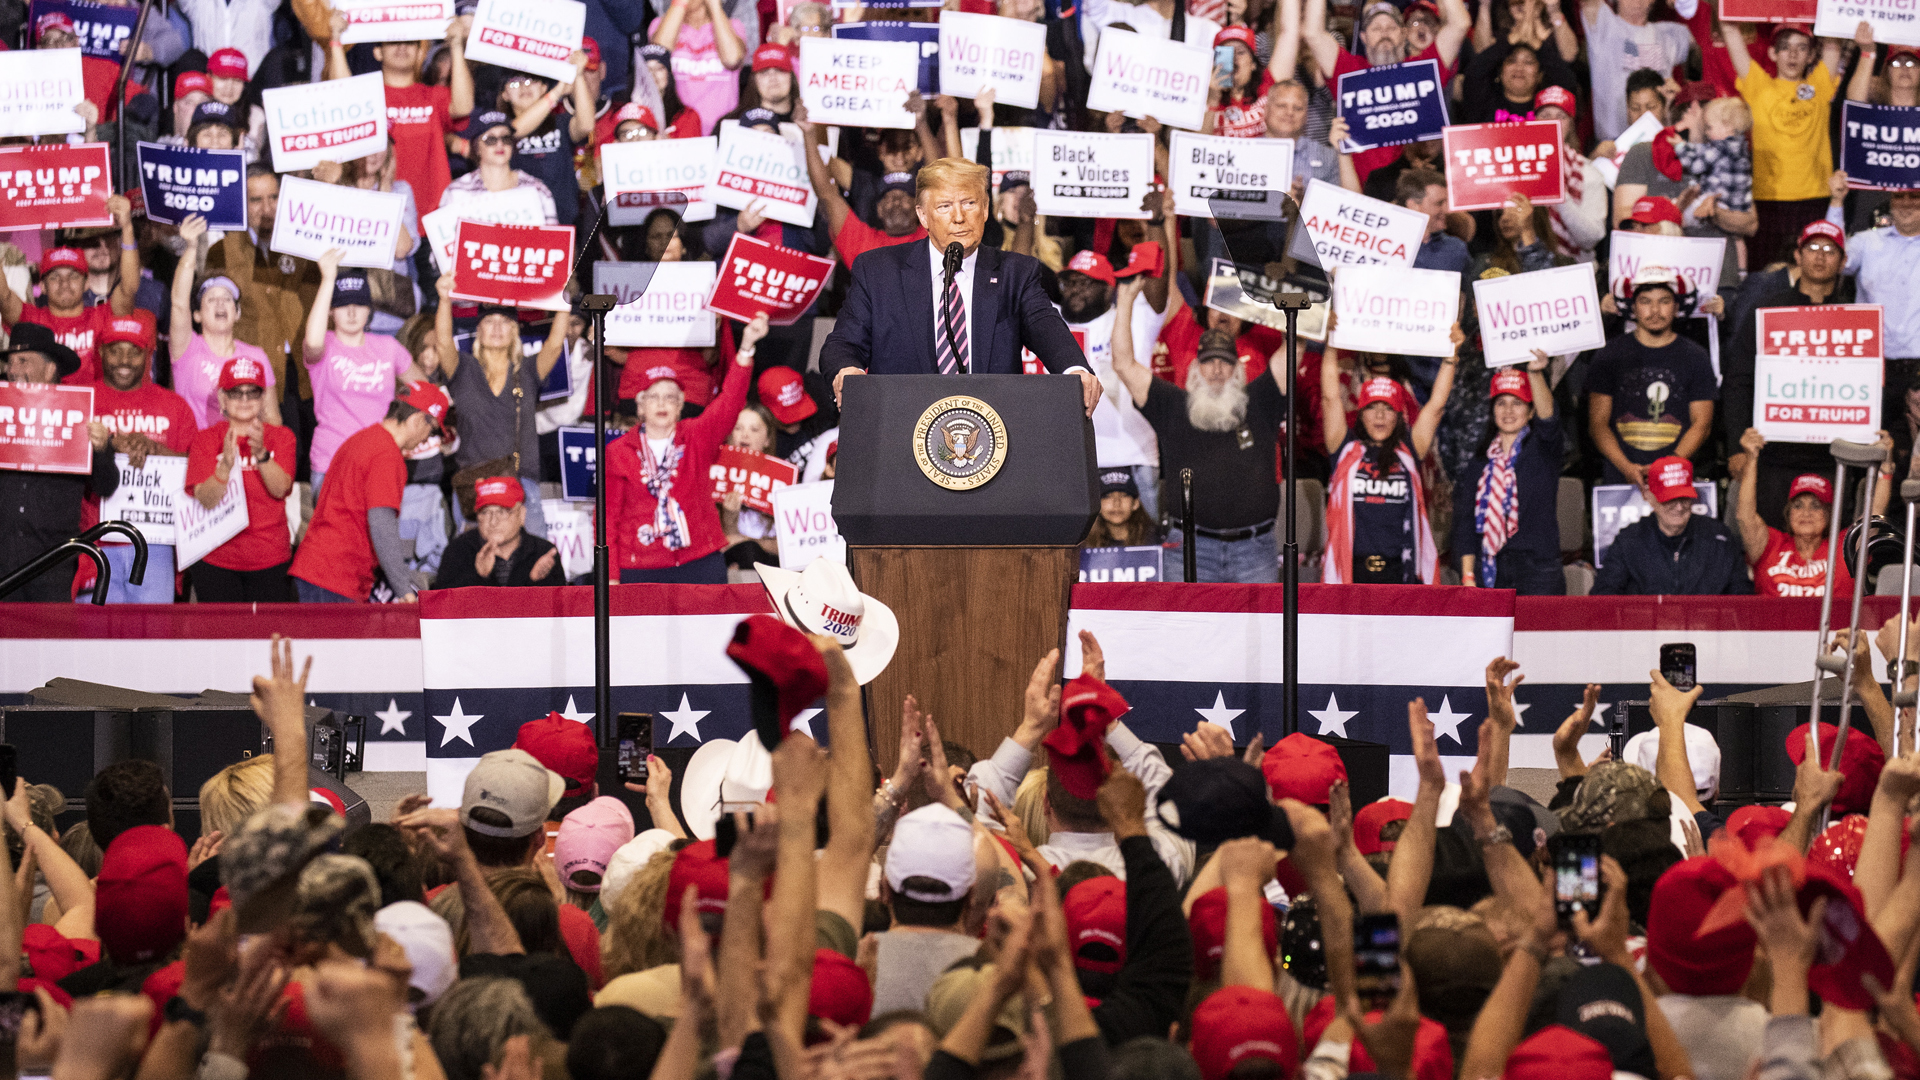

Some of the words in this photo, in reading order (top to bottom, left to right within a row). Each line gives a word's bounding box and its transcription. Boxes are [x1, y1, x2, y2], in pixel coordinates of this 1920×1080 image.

[351, 9, 386, 22] FOR
[388, 4, 442, 20] TRUMP
[487, 1, 574, 41] Latinos
[1838, 7, 1864, 17] FOR
[1870, 10, 1915, 21] TRUMP
[72, 20, 130, 39] UMP
[482, 30, 514, 47] FOR
[516, 37, 570, 59] TRUMP
[948, 35, 1035, 71] Women
[833, 55, 882, 69] KEEP
[808, 73, 908, 92] AMERICA
[955, 65, 976, 75] FOR
[982, 69, 1024, 82] TRUMP
[1107, 52, 1200, 94] Women
[0, 79, 73, 99] omen
[1112, 82, 1138, 94] FOR
[1146, 89, 1188, 104] TRUMP
[1342, 80, 1435, 108] TRUMP
[278, 100, 375, 129] Latinos
[1364, 109, 1418, 130] 2020
[284, 134, 320, 150] FOR
[322, 123, 375, 147] TRUMP
[1846, 121, 1920, 143] TRUM
[725, 144, 810, 184] Latinos
[1053, 145, 1096, 163] Black
[1192, 147, 1235, 166] Black
[1454, 143, 1555, 166] TRUMP
[0, 165, 101, 188] TRUMP
[143, 161, 240, 188] TRUMP
[614, 162, 708, 186] Latinos
[1077, 165, 1130, 182] Voices
[1216, 168, 1268, 186] Voices
[1465, 161, 1548, 177] PENCE
[7, 183, 92, 200] PENCE
[619, 193, 650, 205] FOR
[720, 173, 752, 191] FOR
[756, 181, 806, 205] TRUMP
[1055, 185, 1081, 197] FOR
[1085, 187, 1128, 198] TRUMP
[1191, 187, 1218, 198] FOR
[1221, 189, 1267, 201] TRUMP
[164, 191, 215, 212] 2020
[288, 198, 390, 238] Women
[1337, 204, 1390, 229] KEEP
[295, 229, 322, 241] FOR
[330, 236, 376, 247] TRUMP
[1305, 215, 1407, 260] AMERICA
[464, 241, 565, 266] TRUMP
[471, 258, 555, 277] PENCE
[733, 257, 819, 293] TRUMP
[603, 282, 705, 311] Women
[735, 276, 806, 303] PENCE
[1342, 286, 1447, 320] Women
[1486, 294, 1588, 330] Women
[614, 315, 642, 323] FOR
[649, 315, 697, 323] TRUMP
[1352, 319, 1383, 328] FOR
[1388, 321, 1435, 333] TRUMP
[1502, 330, 1528, 341] FOR
[1533, 320, 1581, 337] TRUMP
[1769, 328, 1874, 347] TRUMP
[1779, 345, 1864, 357] PENCE
[1767, 373, 1870, 401] Latinos
[0, 406, 84, 427] RUMP
[972, 402, 984, 412] THE
[1768, 406, 1804, 420] FOR
[1807, 408, 1866, 421] TRUMP
[916, 398, 960, 440] PRESIDENT
[6, 424, 73, 440] ENCE
[985, 410, 1005, 450] UNITED
[917, 442, 925, 457] THE
[920, 457, 929, 467] OF
[967, 457, 1000, 486] STATES
[122, 469, 161, 487] Black
[927, 464, 952, 485] SEAL
[1353, 478, 1407, 497] RUMP
[144, 490, 172, 507] Voic
[122, 511, 146, 523] FOR
[148, 512, 173, 524] TRU
[188, 525, 205, 541] FOR
[208, 504, 235, 529] TRUMP
[799, 536, 827, 548] FOR
[820, 602, 862, 627] TRUM
[822, 619, 857, 637] 2020
